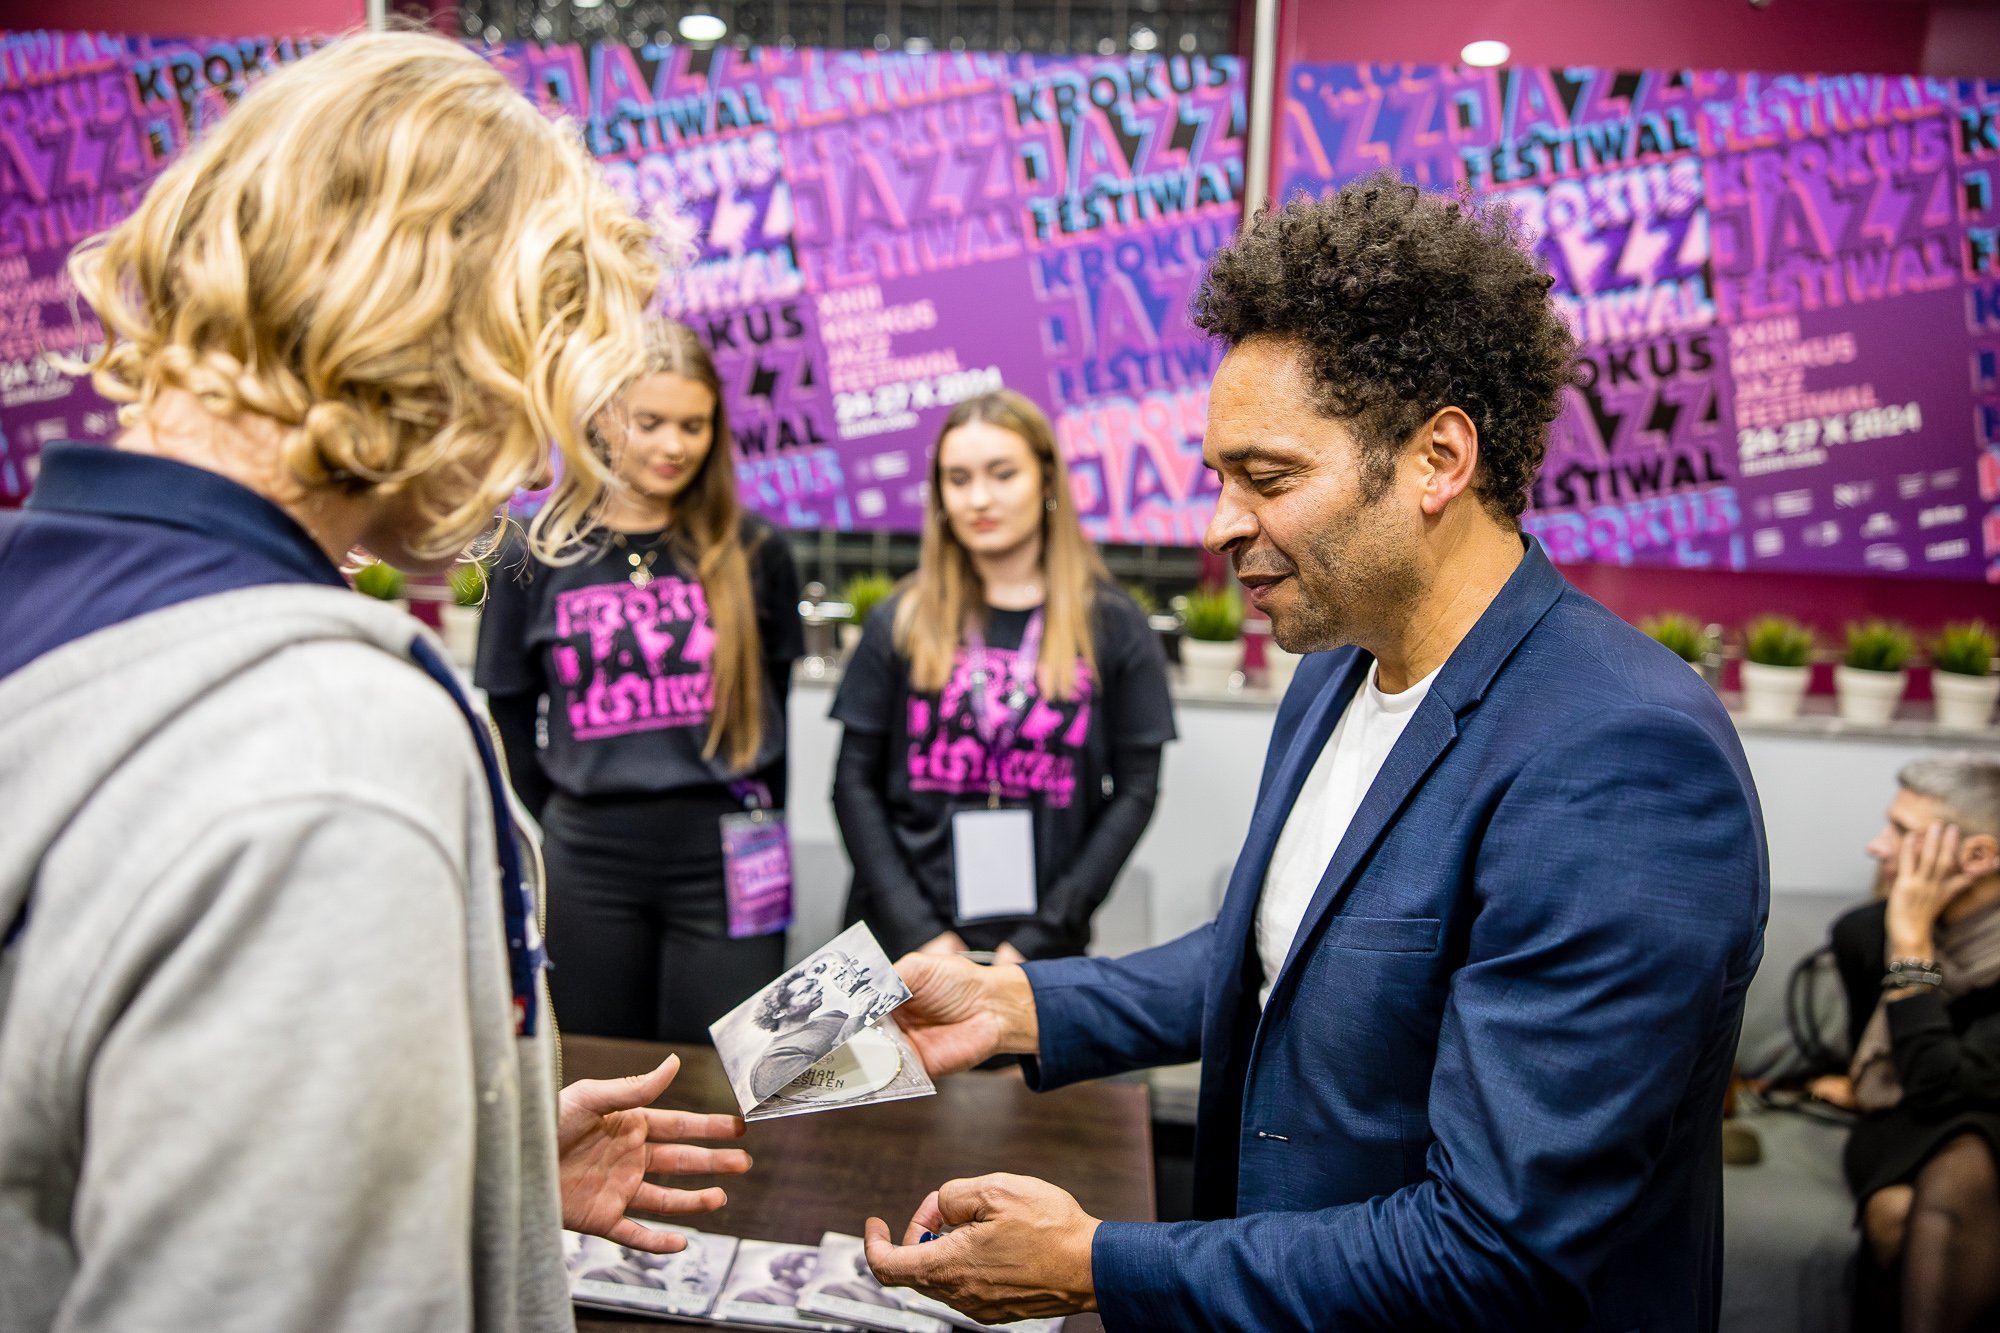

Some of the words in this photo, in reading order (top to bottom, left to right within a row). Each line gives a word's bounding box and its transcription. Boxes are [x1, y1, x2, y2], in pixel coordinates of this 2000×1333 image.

[132, 42, 326, 108] KROKU
[1010, 54, 1240, 126] KROKUS
[586, 84, 772, 155] ESTIWAL
[1034, 226, 1226, 298] KROKU
[708, 304, 806, 352] KUS
[1566, 335, 1716, 392] OKUS
[1532, 448, 1728, 510] ESTIWAL
[790, 1076, 845, 1089] ESLIEN
